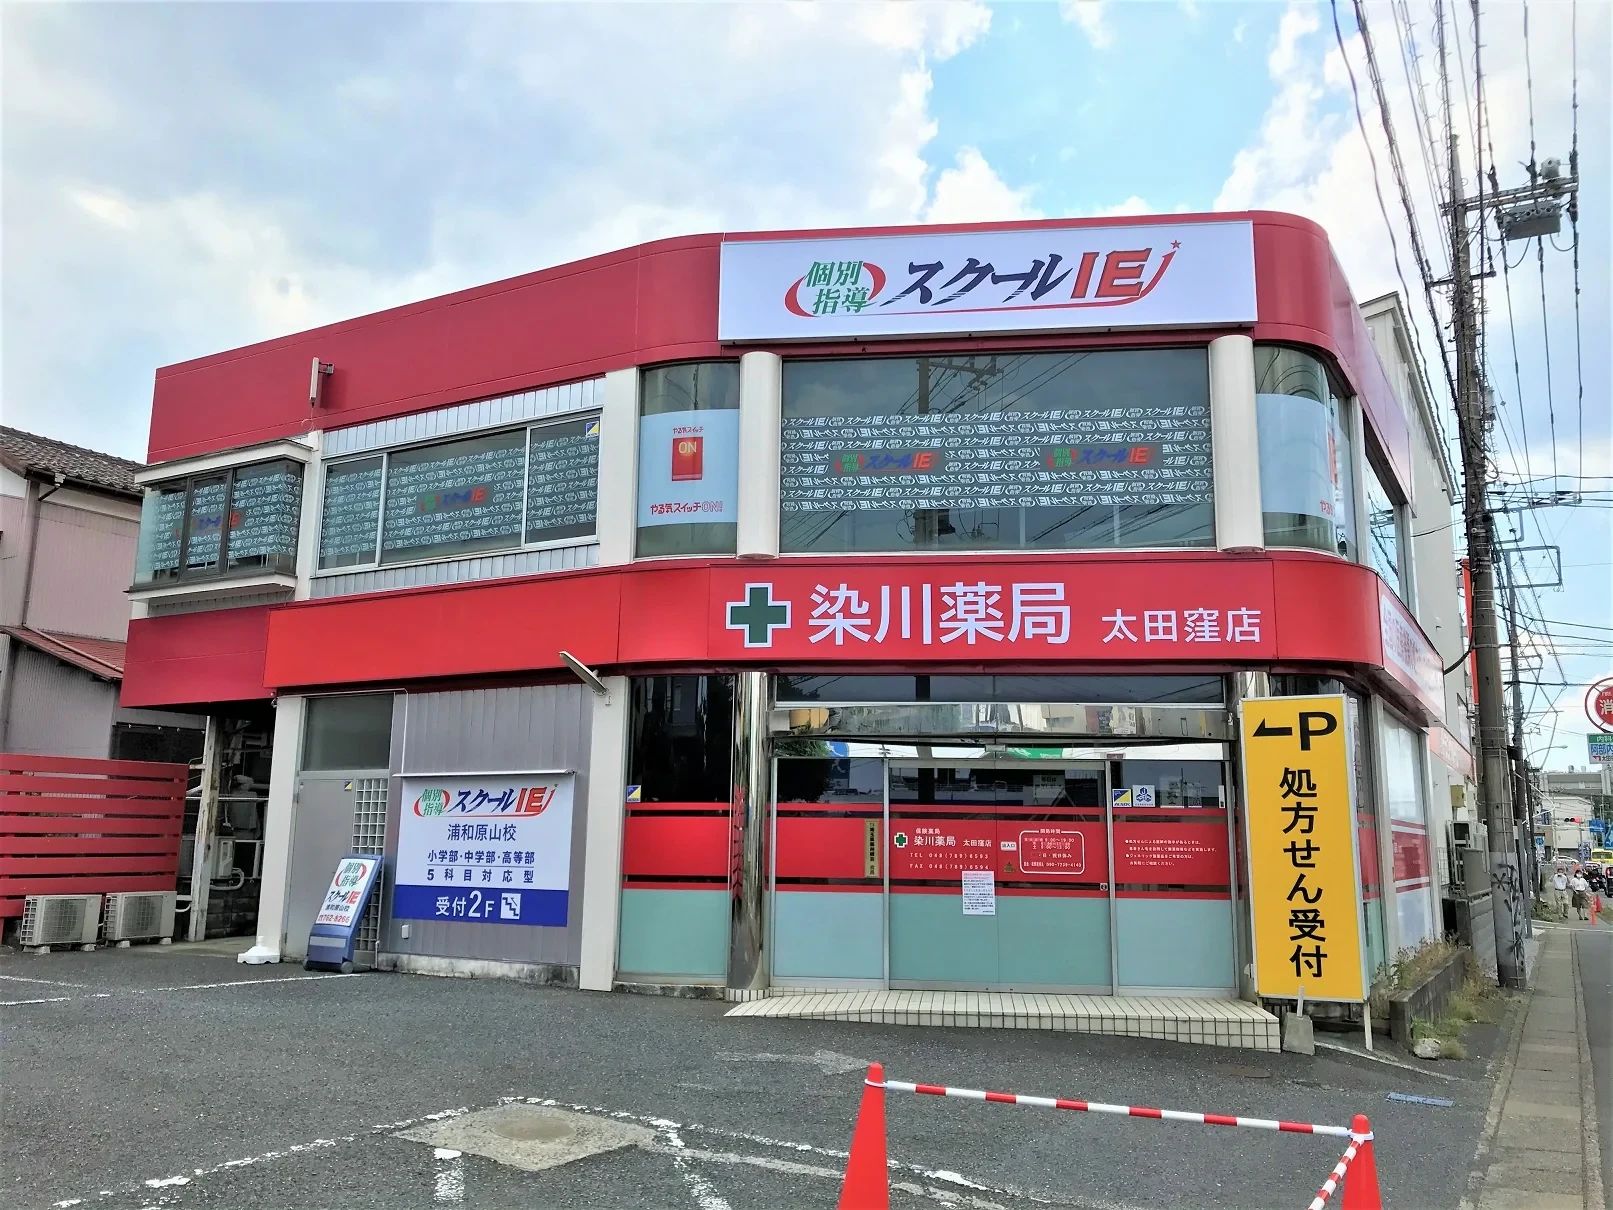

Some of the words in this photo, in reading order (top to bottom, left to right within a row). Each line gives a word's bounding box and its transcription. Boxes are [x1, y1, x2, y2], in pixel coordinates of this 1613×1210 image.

[806, 261, 864, 287] 個別
[880, 247, 1152, 306] スクールIE
[812, 287, 869, 315] 指導
[678, 441, 696, 454] ON
[808, 582, 1071, 645] 染川薬局
[1102, 607, 1261, 643] 太田窪店
[1298, 712, 1338, 751] P
[422, 788, 442, 802] 個別
[447, 787, 548, 813] スクールIE
[423, 802, 445, 816] 指導
[448, 824, 516, 841] 浦和原山校
[914, 836, 956, 846] 染川薬局
[1280, 767, 1328, 978] 処方せん受付
